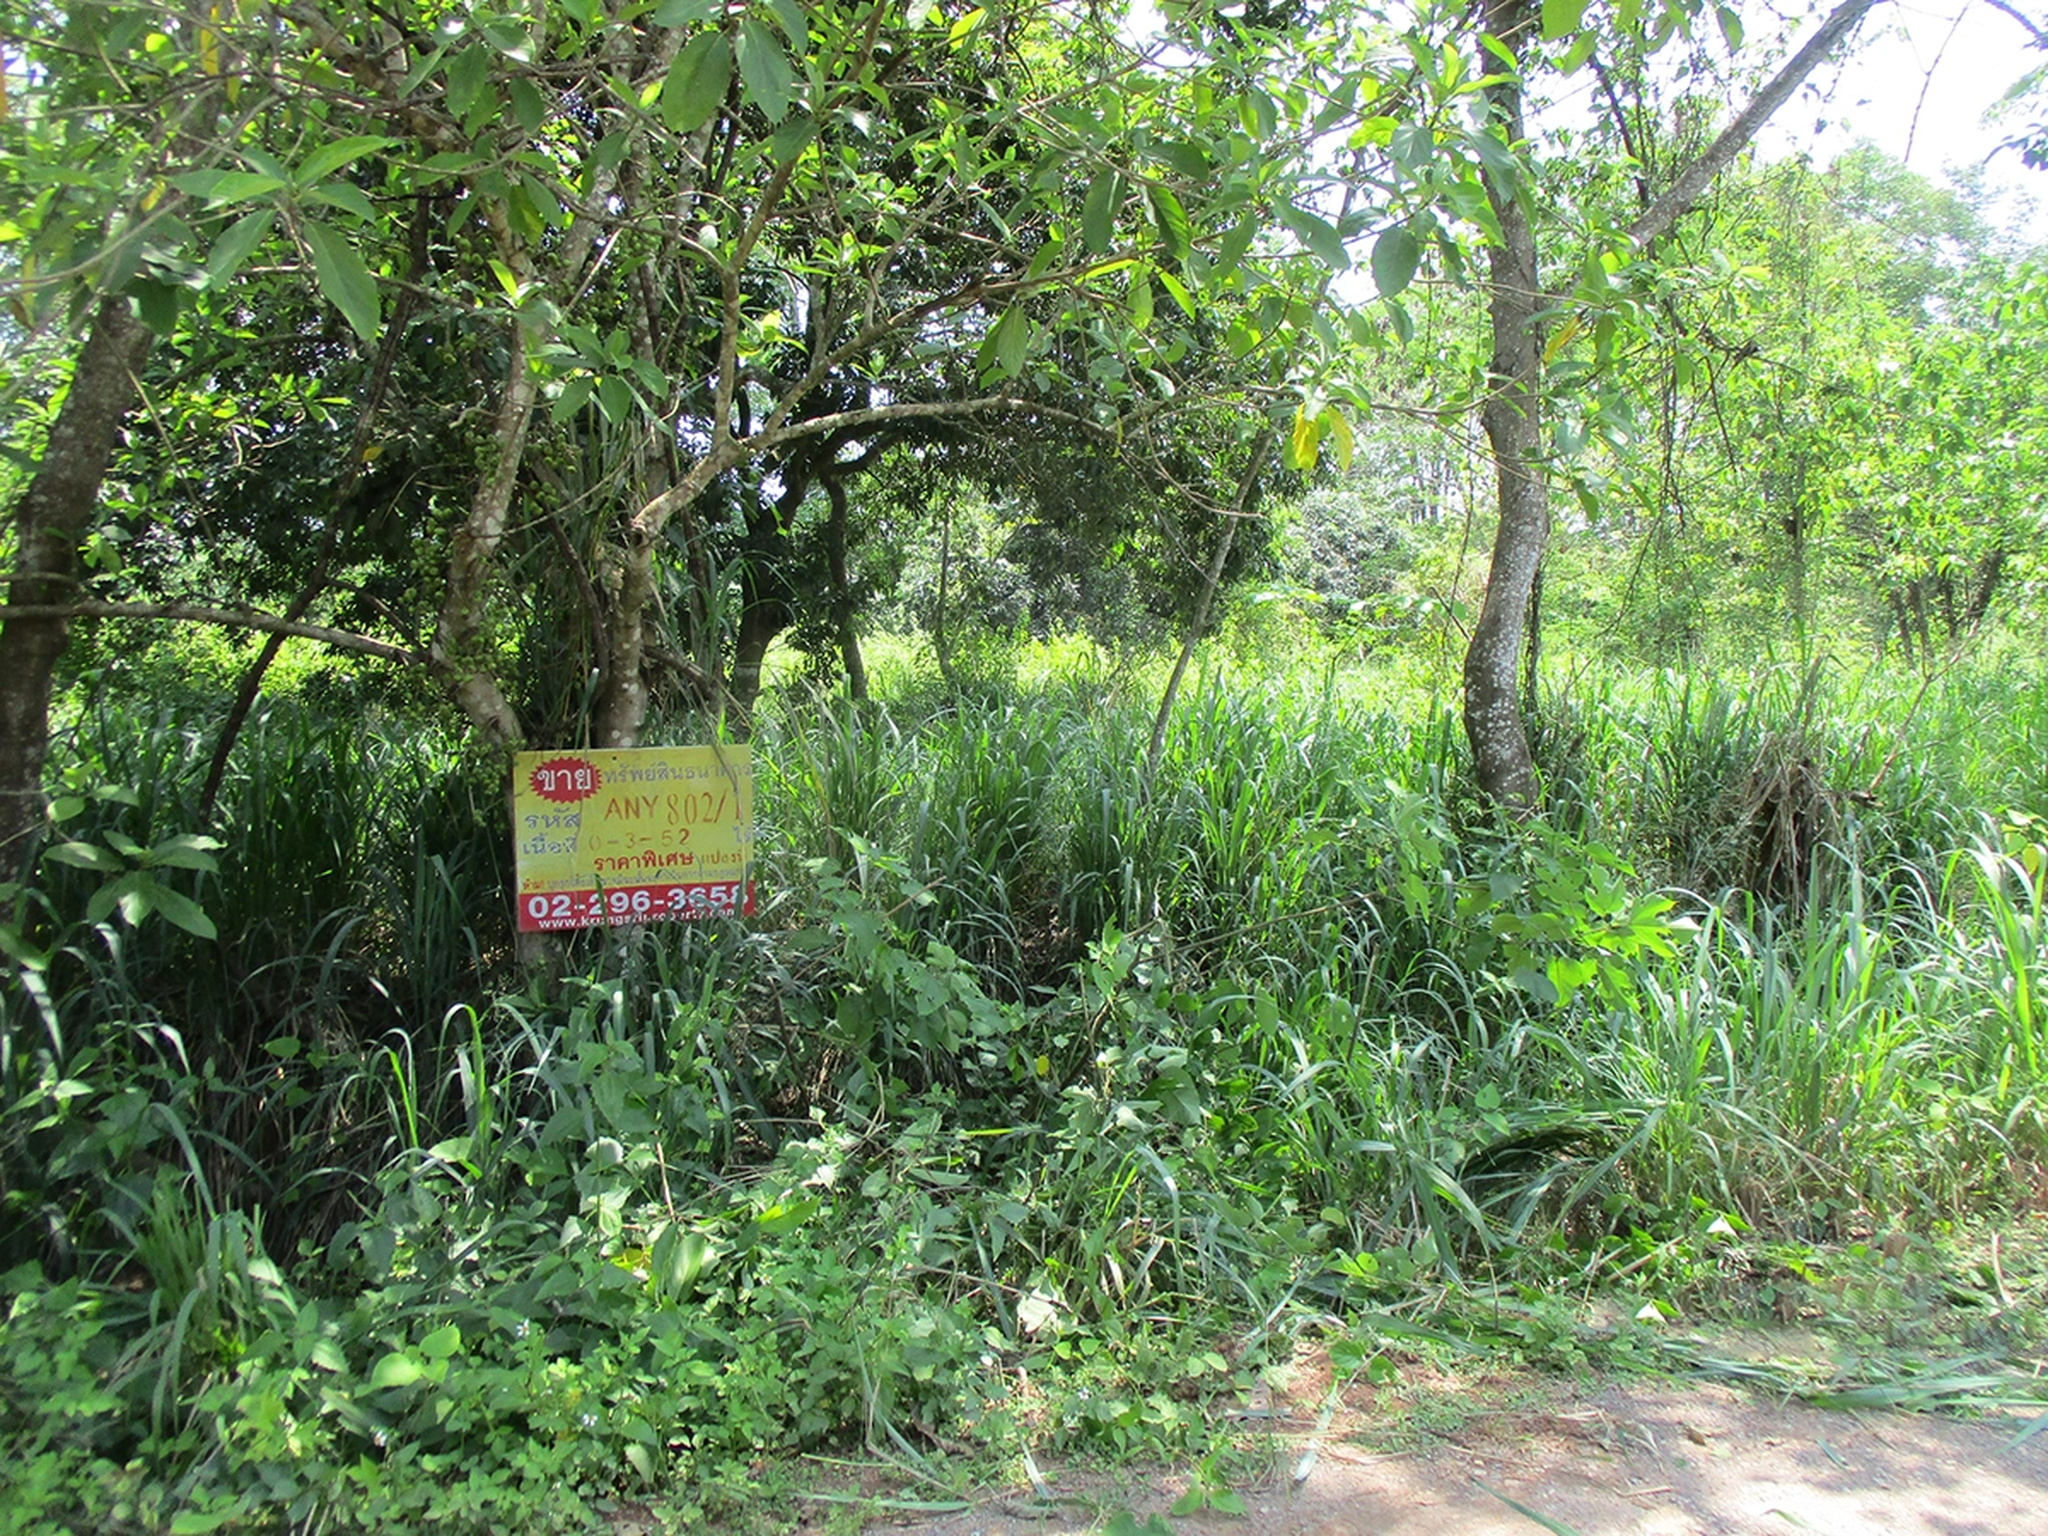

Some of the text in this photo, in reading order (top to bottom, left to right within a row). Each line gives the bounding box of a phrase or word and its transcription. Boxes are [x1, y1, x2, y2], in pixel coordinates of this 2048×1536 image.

[536, 768, 592, 792] ขาย
[524, 806, 580, 830] รหัส
[604, 794, 659, 821] ANY
[594, 849, 694, 872] ราคาพิเศษ
